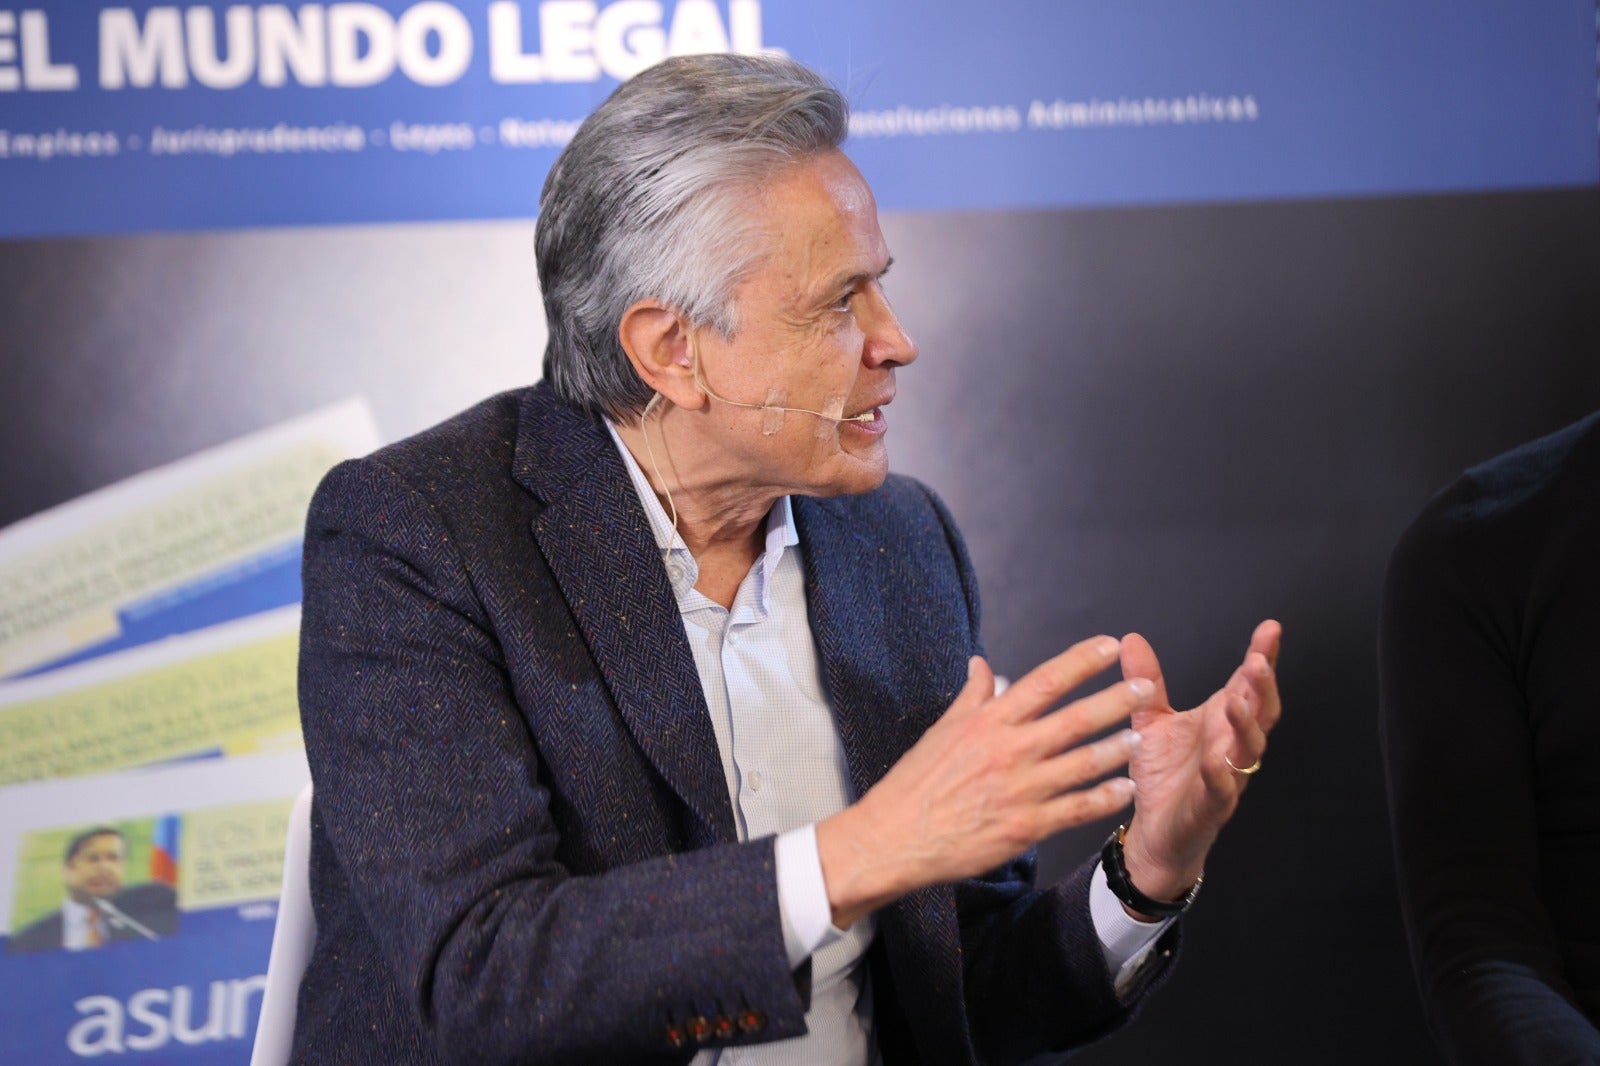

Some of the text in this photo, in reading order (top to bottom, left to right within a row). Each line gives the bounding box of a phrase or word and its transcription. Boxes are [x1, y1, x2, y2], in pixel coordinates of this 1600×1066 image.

[100, 2, 474, 90] MUNDO
[487, 0, 789, 85] LEGAL
[150, 123, 367, 156] Jurisprudencia
[848, 103, 1022, 137] esoluciones
[1027, 95, 1259, 130] Administrativas
